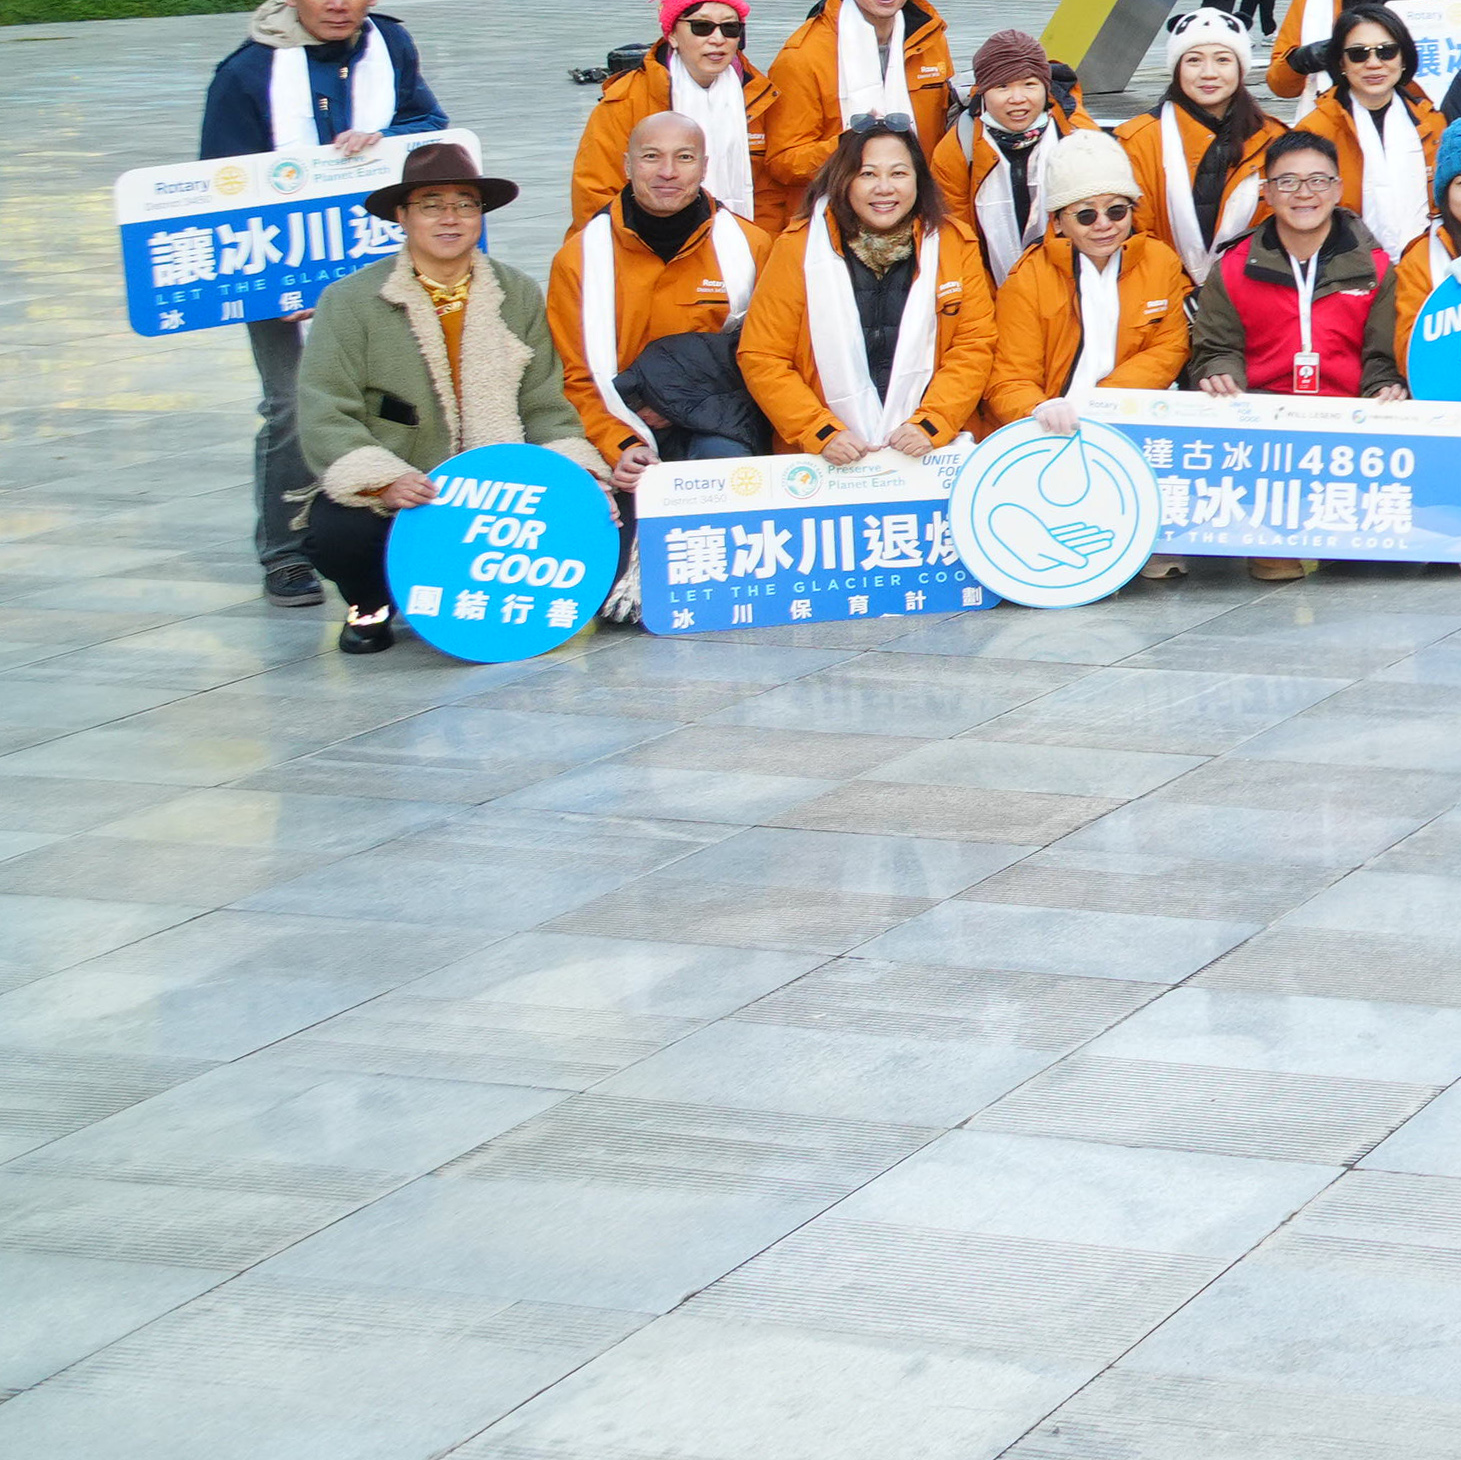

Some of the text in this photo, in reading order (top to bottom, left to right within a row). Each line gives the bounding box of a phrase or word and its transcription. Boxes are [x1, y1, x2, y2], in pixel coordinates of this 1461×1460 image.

[1407, 11, 1441, 21] Rotary
[313, 166, 391, 183] Planet Earth
[154, 179, 210, 196] Rotary
[156, 289, 201, 306] LET
[219, 278, 266, 294] THE
[922, 454, 960, 466] UNITE
[1143, 437, 1416, 480] 達古冰川4860
[828, 464, 882, 475] Preserve
[674, 478, 725, 491] Rotary
[828, 476, 905, 490] Planet Earth
[432, 475, 547, 515] UNITE
[462, 514, 547, 550] FOR
[1188, 530, 1230, 544] THE
[1242, 533, 1337, 548] GLACIER
[1350, 536, 1409, 550] COOL
[470, 551, 586, 589] GOOD
[669, 570, 967, 603] LET THE GLACIER COO
[671, 585, 983, 630] 冰川保育計劃
